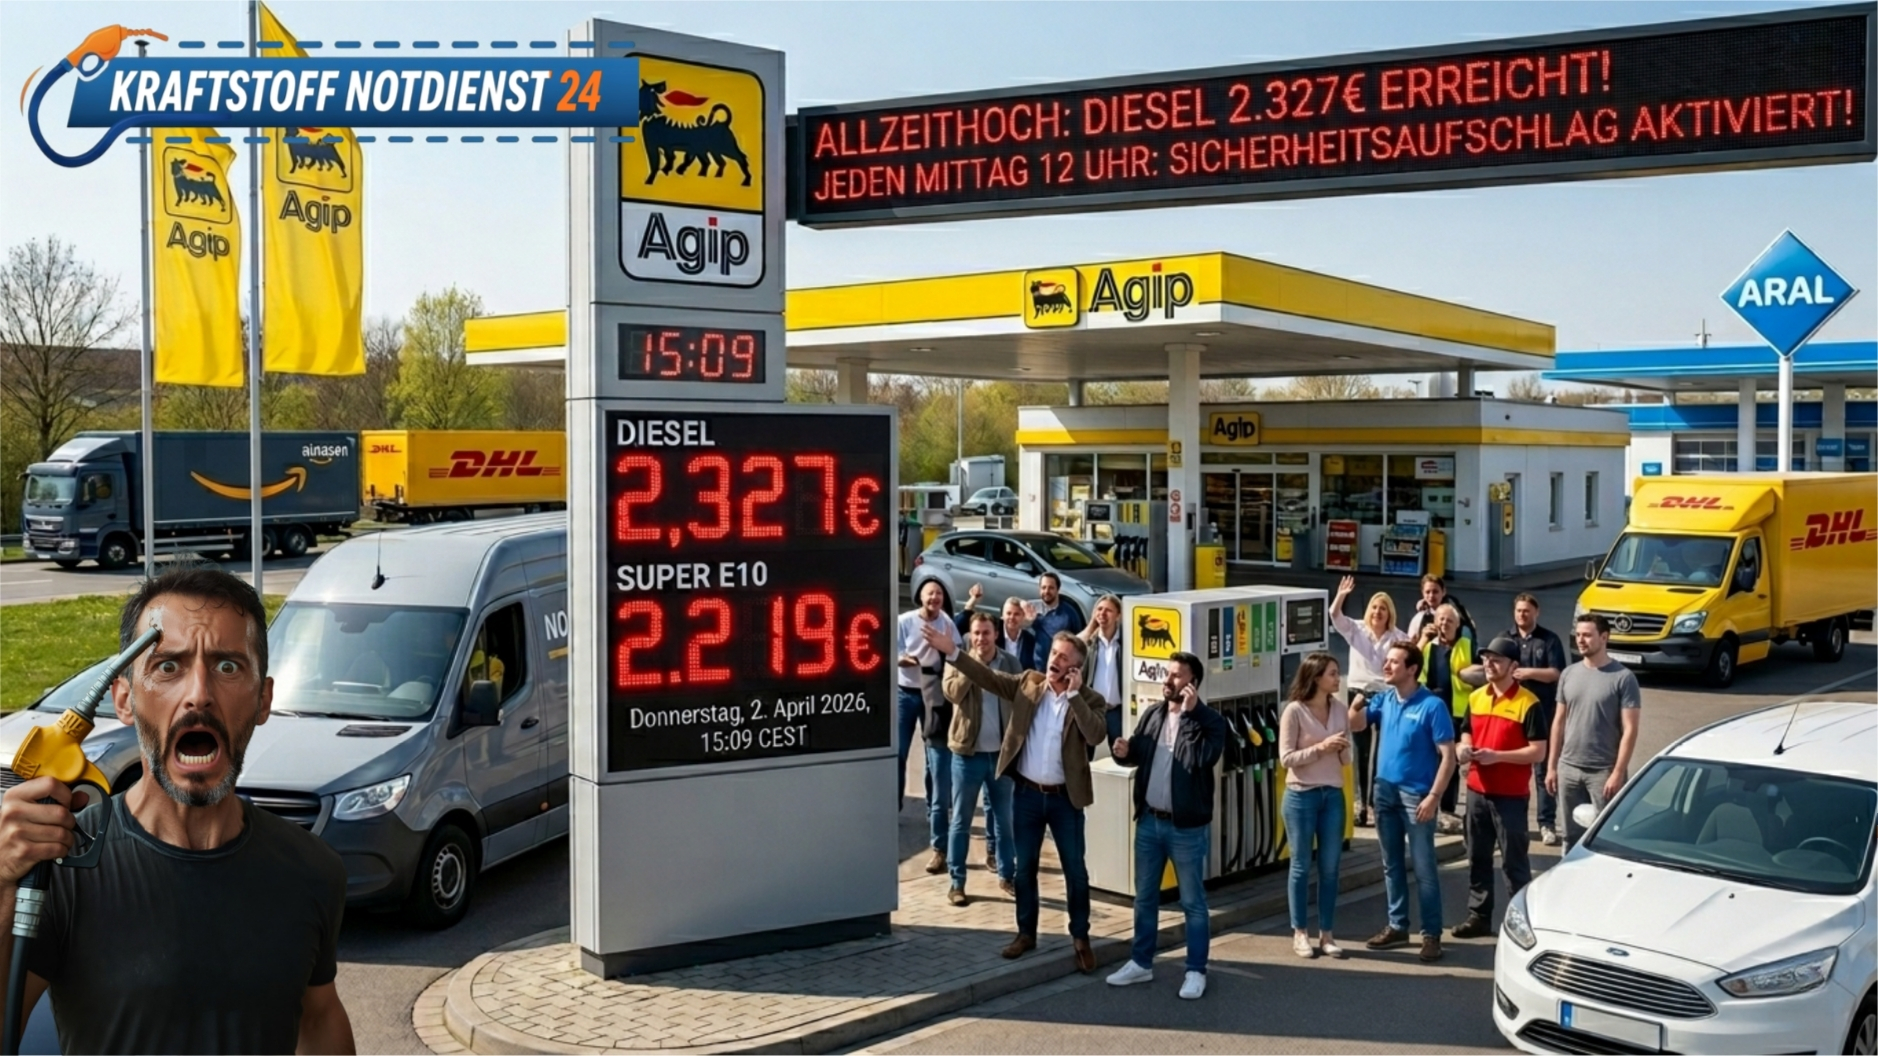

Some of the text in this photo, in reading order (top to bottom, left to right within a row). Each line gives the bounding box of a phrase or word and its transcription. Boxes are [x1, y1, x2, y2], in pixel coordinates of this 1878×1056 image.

[814, 50, 1611, 158] ALLZEITHOCH: DIESEL 2.327€ ERREICHT!
[814, 89, 1853, 200] JEDEN MITTAG 12 UHR: SICHERHEITSAUFSCHLAG AKTIVIERT!
[279, 190, 352, 233] Agip
[167, 221, 230, 261] Agip
[637, 212, 750, 276] Agip
[1088, 262, 1194, 322] Agip
[1737, 274, 1835, 308] ARAL
[643, 331, 755, 378] 15:09
[371, 444, 396, 453] DHL
[617, 419, 716, 446] DIESEL
[449, 450, 543, 477] DHL
[617, 455, 880, 548] 2,327€
[1660, 496, 1722, 510] DHL
[1805, 509, 1867, 549] DHL
[617, 561, 768, 591] SUPER E10
[630, 692, 871, 729] Donnerstag, 2. April 2026,
[701, 725, 808, 752] 15:09 CEST
